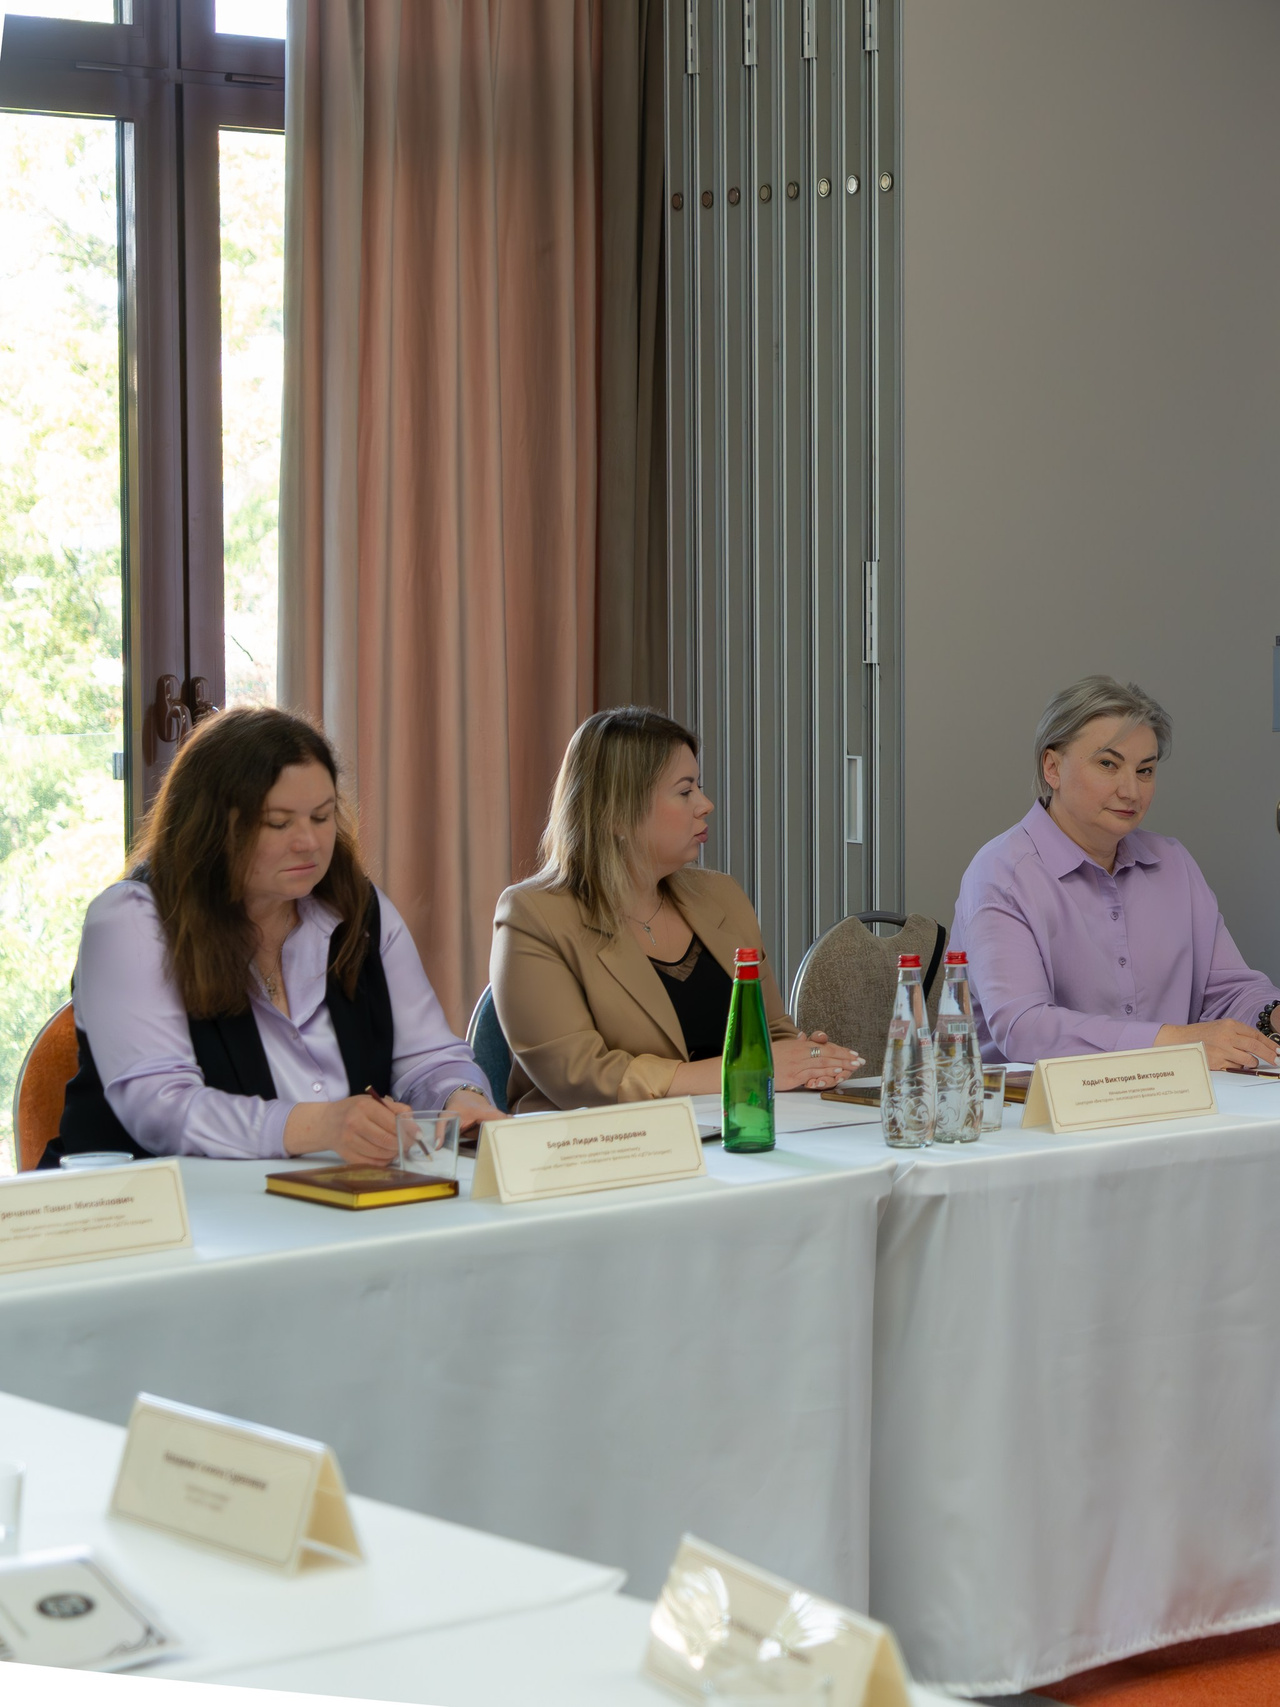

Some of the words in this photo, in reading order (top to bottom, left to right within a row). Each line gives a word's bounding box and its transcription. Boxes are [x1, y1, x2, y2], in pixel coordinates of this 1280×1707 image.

[1082, 1078, 1104, 1087] Ходыч
[1105, 1073, 1136, 1083] Виктория
[1137, 1070, 1175, 1081] Викторовна
[547, 1140, 571, 1150] Берая
[572, 1137, 598, 1147] Лидия
[600, 1129, 647, 1143] Эдуардовна
[1, 1207, 41, 1221] речаник
[74, 1196, 135, 1210] Михайлович
